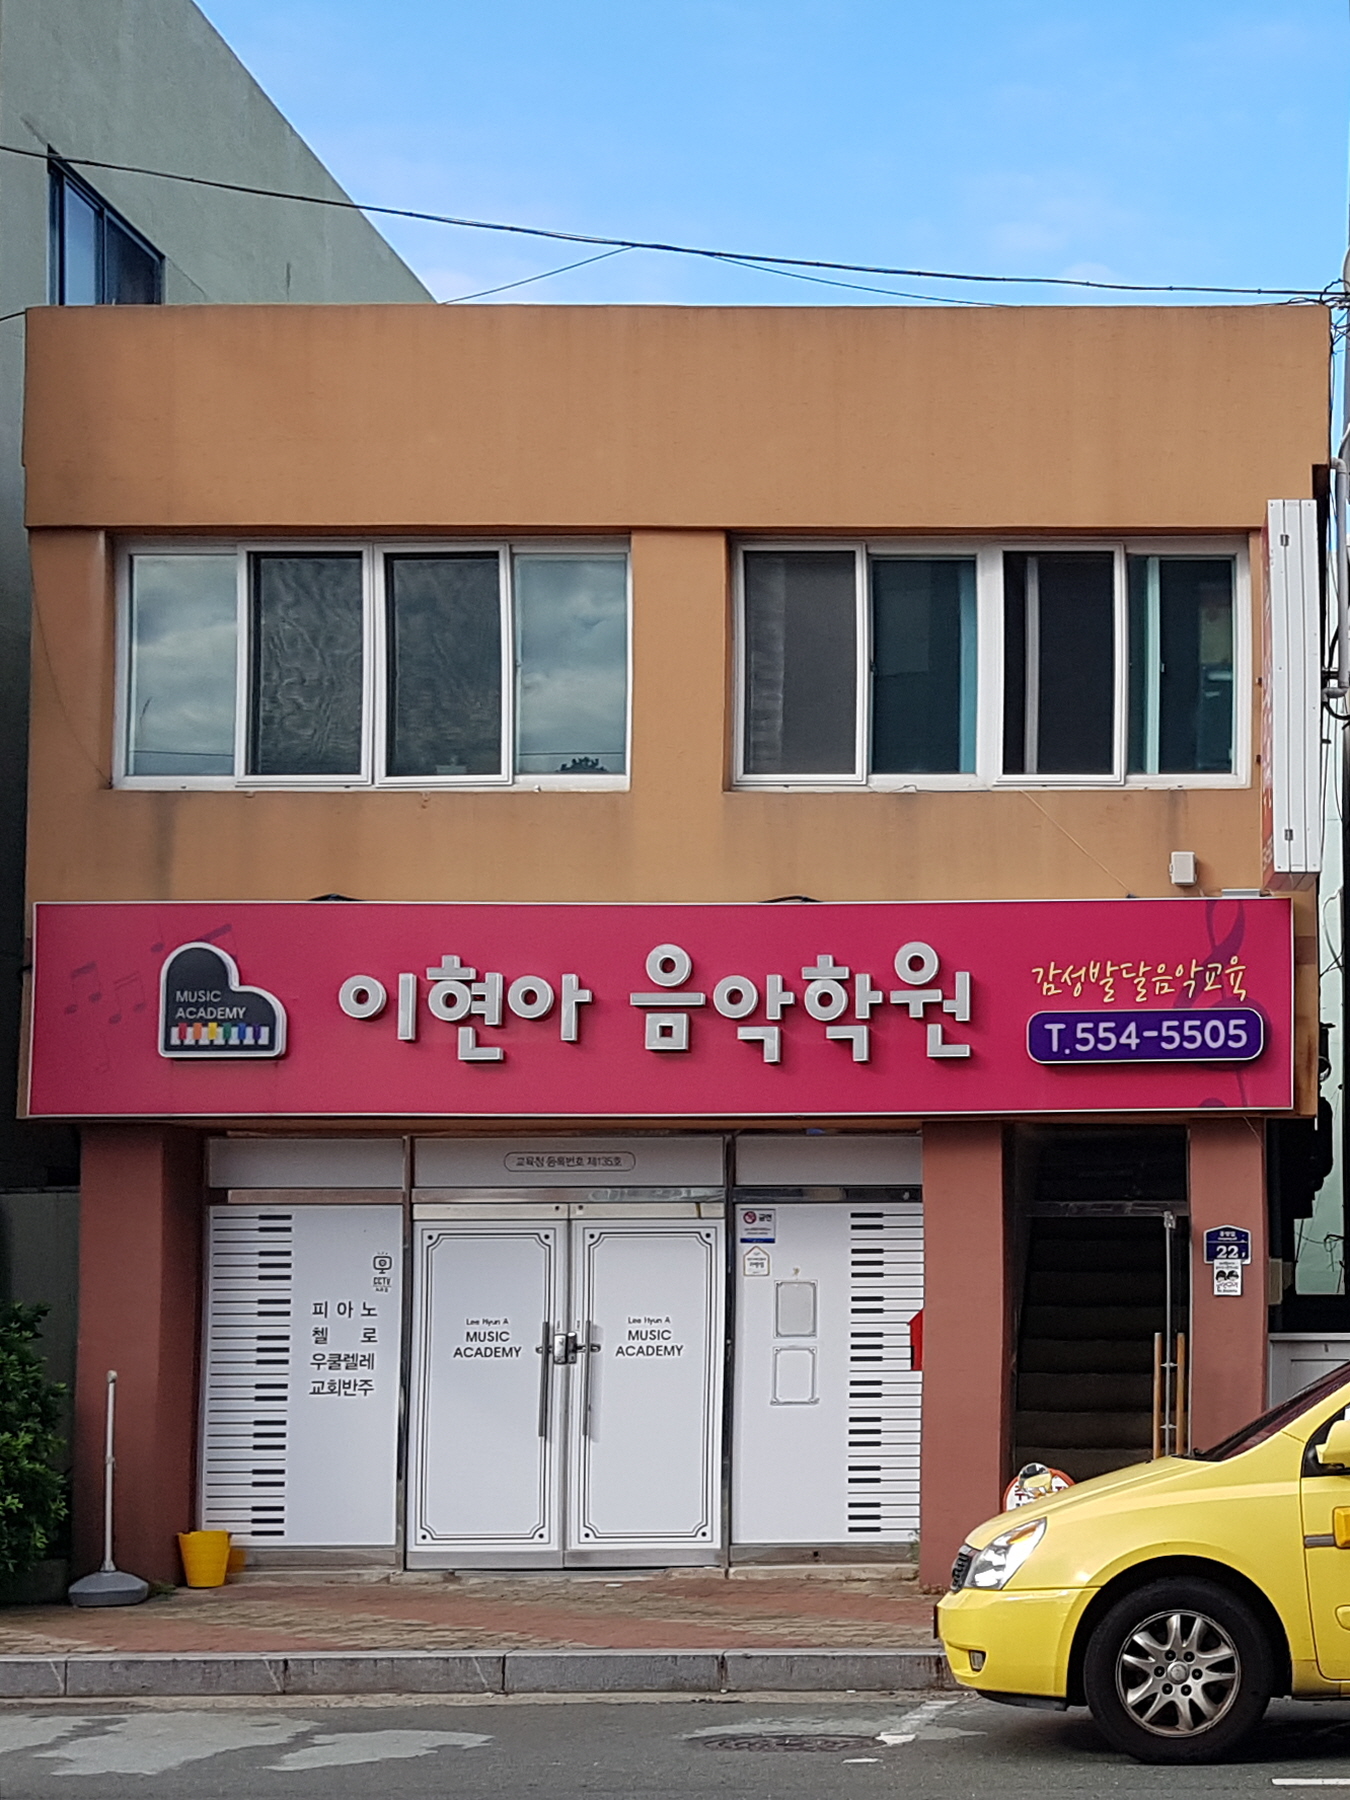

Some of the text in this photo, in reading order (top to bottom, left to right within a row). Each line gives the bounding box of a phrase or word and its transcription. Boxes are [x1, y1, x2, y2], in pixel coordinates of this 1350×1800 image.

[175, 990, 222, 1002] MUSIC
[338, 941, 971, 1064] 이현아 음악학원
[175, 1007, 246, 1019] ACADEMY
[1044, 1018, 1248, 1055] T.554-5505
[1216, 1245, 1239, 1259] 22
[373, 1276, 391, 1286] CCTV
[466, 1318, 480, 1326] Lee
[482, 1318, 501, 1327] Hyun
[628, 1316, 671, 1326] Lee Hyun A
[465, 1331, 511, 1343] MUSIC
[627, 1329, 672, 1341] MUSIC
[453, 1346, 522, 1358] ACADEMY
[615, 1344, 684, 1357] ACADEMY
[309, 1352, 375, 1371] 우쿨렐레
[308, 1378, 375, 1397] 교회반주
